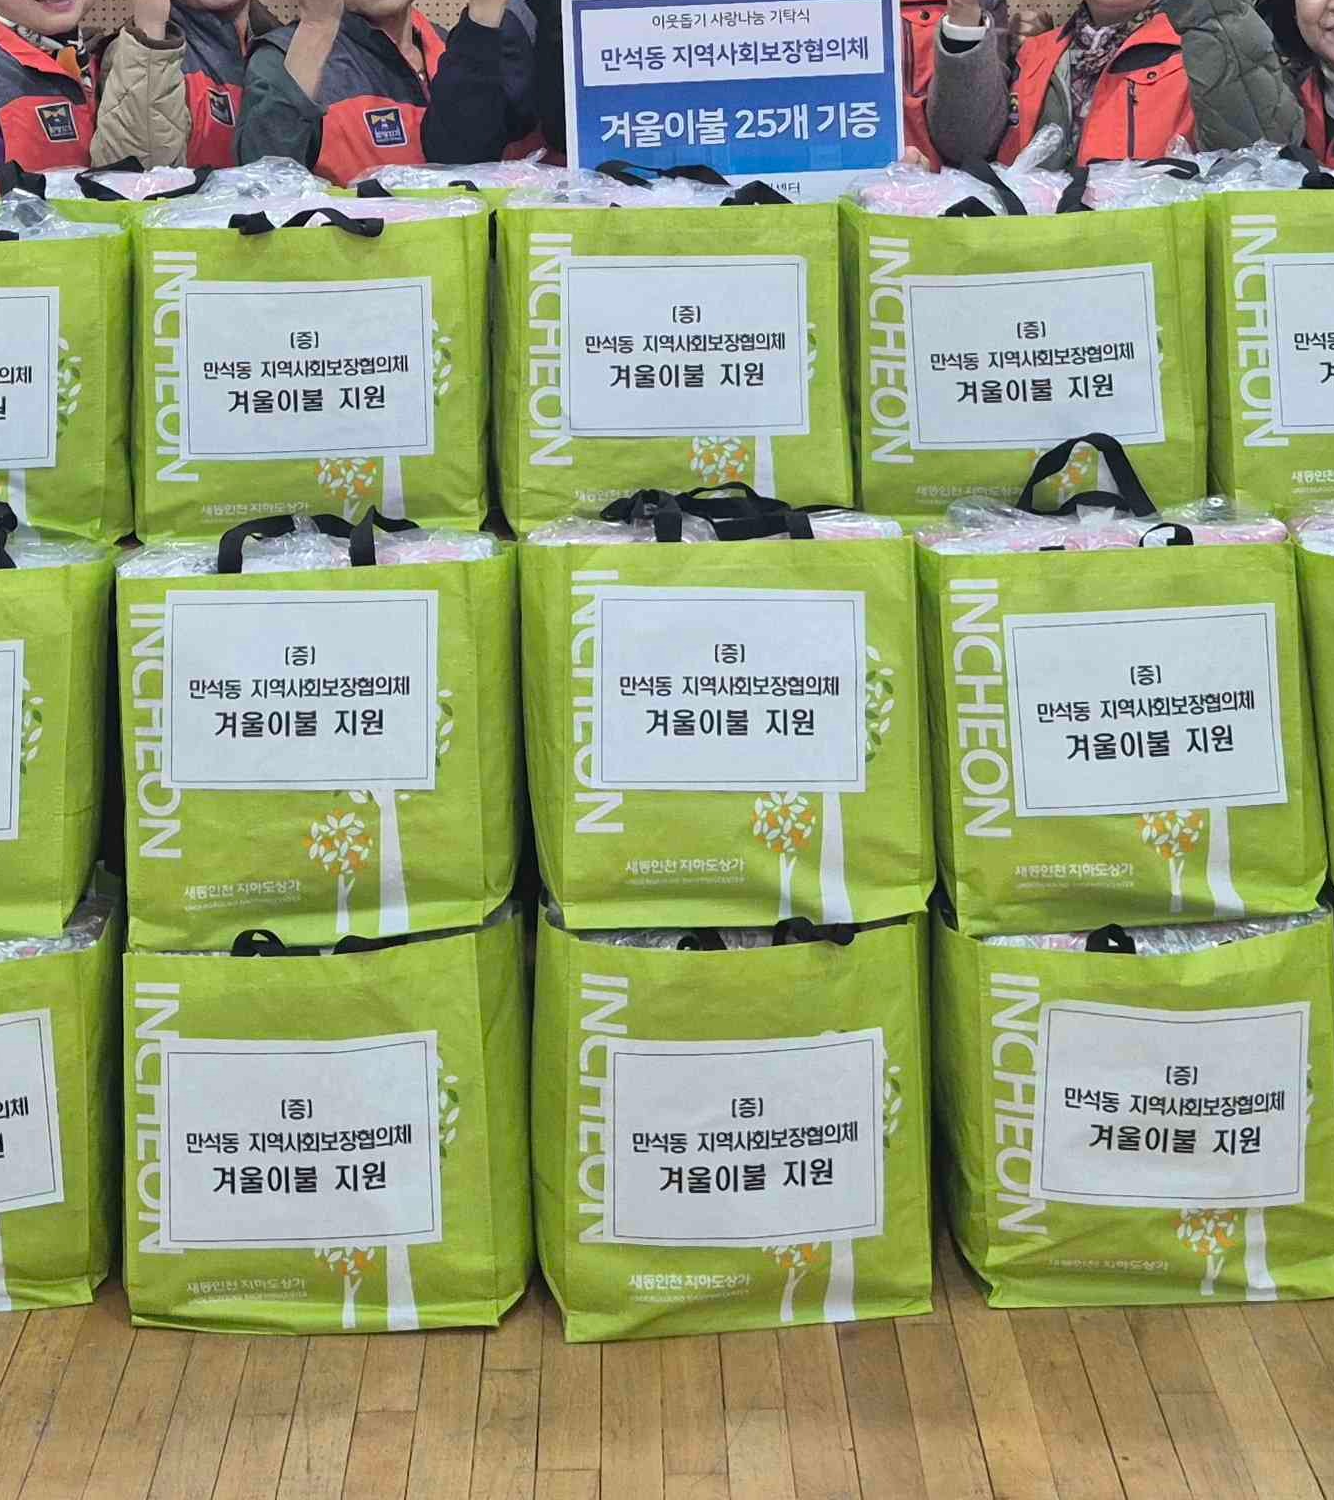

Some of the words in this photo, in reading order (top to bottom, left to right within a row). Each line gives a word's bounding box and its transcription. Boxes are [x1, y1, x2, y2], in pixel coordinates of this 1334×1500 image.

[601, 46, 666, 71] 만석동
[672, 36, 868, 68] 지역사회보장협의체
[600, 108, 728, 149] 겨울이불
[735, 103, 808, 140] 25개
[817, 101, 881, 140] 기증
[585, 336, 634, 353] 만석동
[643, 333, 785, 353] 지역사회보장협의체
[1231, 215, 1289, 447] INCHEON
[529, 234, 573, 466] INCHEON
[869, 236, 914, 464] INCHEON
[931, 353, 979, 371] 만석동
[988, 342, 1134, 369] 지역사회보장협의체
[203, 361, 251, 380] 만석동
[261, 356, 408, 378] 지역사회보장협의체
[609, 364, 704, 388] 겨울이불
[720, 362, 764, 386] 지원
[228, 388, 323, 414] 겨울이불
[340, 385, 386, 409] 지원
[956, 378, 1052, 403] 겨울이불
[1068, 373, 1114, 399] 지원
[189, 679, 241, 699] 만석동
[251, 676, 410, 698] 지역사회보장협의체
[620, 676, 671, 697] 만석동
[682, 676, 839, 696] 지역사회보장협의체
[949, 579, 1012, 838] INCHEON
[1037, 701, 1090, 723] 만석동
[1100, 690, 1255, 719] 지역사회보장협의체
[215, 710, 318, 737] 겨울이불
[335, 709, 385, 736] 지원
[646, 709, 748, 736] 겨울이불
[766, 709, 815, 736] 지원
[1066, 730, 1169, 760] 겨울이불
[1186, 725, 1234, 754] 지원
[991, 973, 1049, 1235] INCHEON
[1065, 1087, 1120, 1113] 만석동
[1129, 1091, 1285, 1116] 지역사회보장협의체
[186, 1133, 239, 1154] 만석동
[249, 1124, 411, 1152] 지역사회보장협의체
[633, 1132, 687, 1154] 만석동
[697, 1121, 858, 1153] 지역사회보장협의체
[1089, 1124, 1196, 1153] 겨울이불
[1213, 1126, 1261, 1155] 지원
[212, 1166, 317, 1194] 겨울이불
[335, 1161, 387, 1192] 지원
[659, 1164, 766, 1193] 겨울이불
[783, 1157, 834, 1187] 지원
